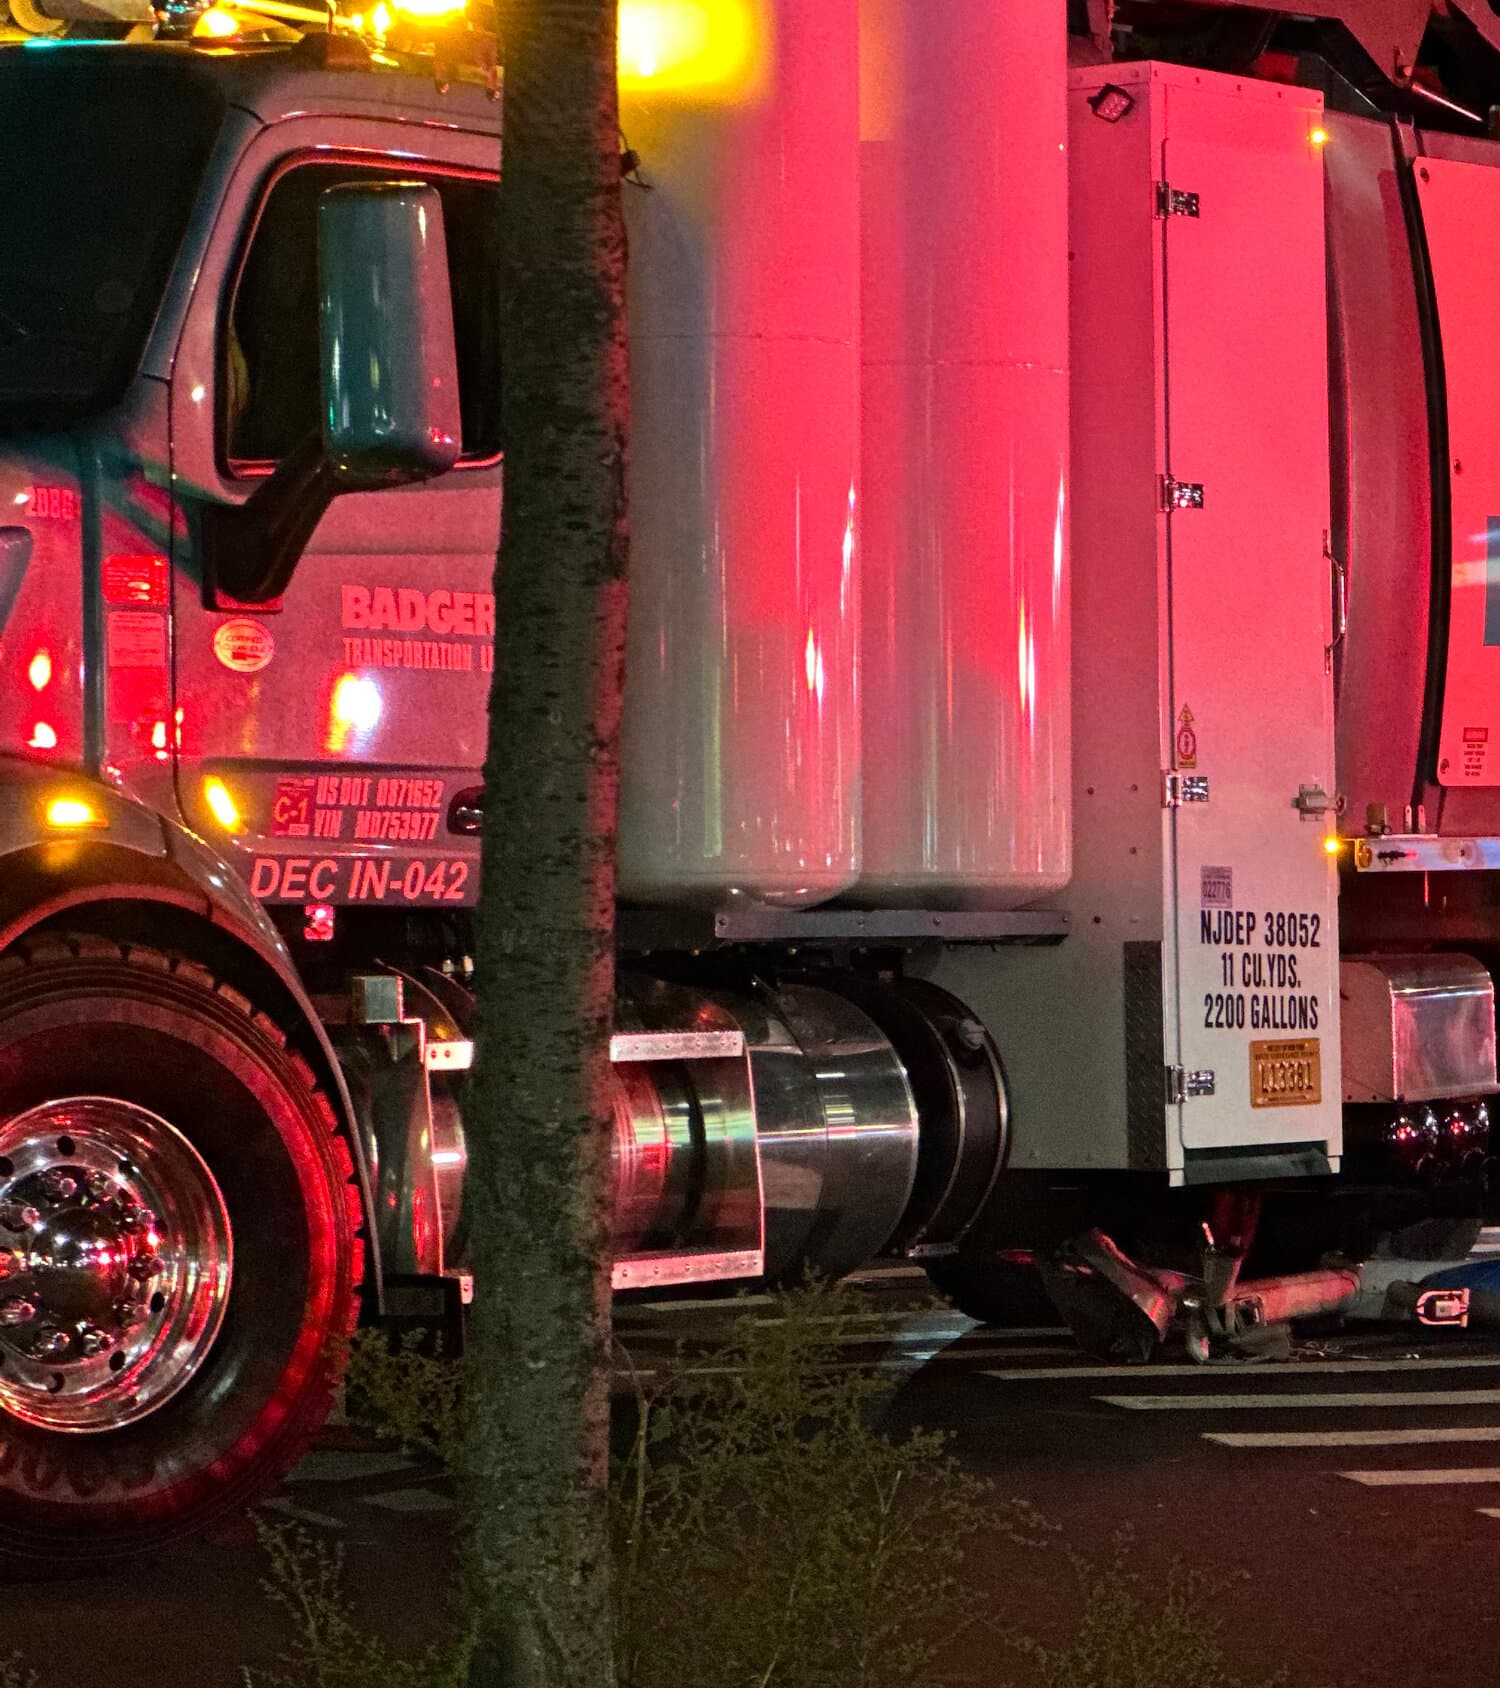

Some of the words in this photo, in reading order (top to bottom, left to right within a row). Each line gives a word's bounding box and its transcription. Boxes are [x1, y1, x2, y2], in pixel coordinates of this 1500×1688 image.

[341, 584, 495, 636] BADGER
[342, 637, 472, 671] TRANSPORTATION
[250, 858, 338, 899] DEC
[347, 860, 468, 900] IN-042
[1200, 910, 1256, 945] NJDEP
[1264, 912, 1320, 948] 38052
[1221, 952, 1234, 987] 11
[1204, 993, 1245, 1029] 2200
[1250, 995, 1319, 1030] GALLONS
